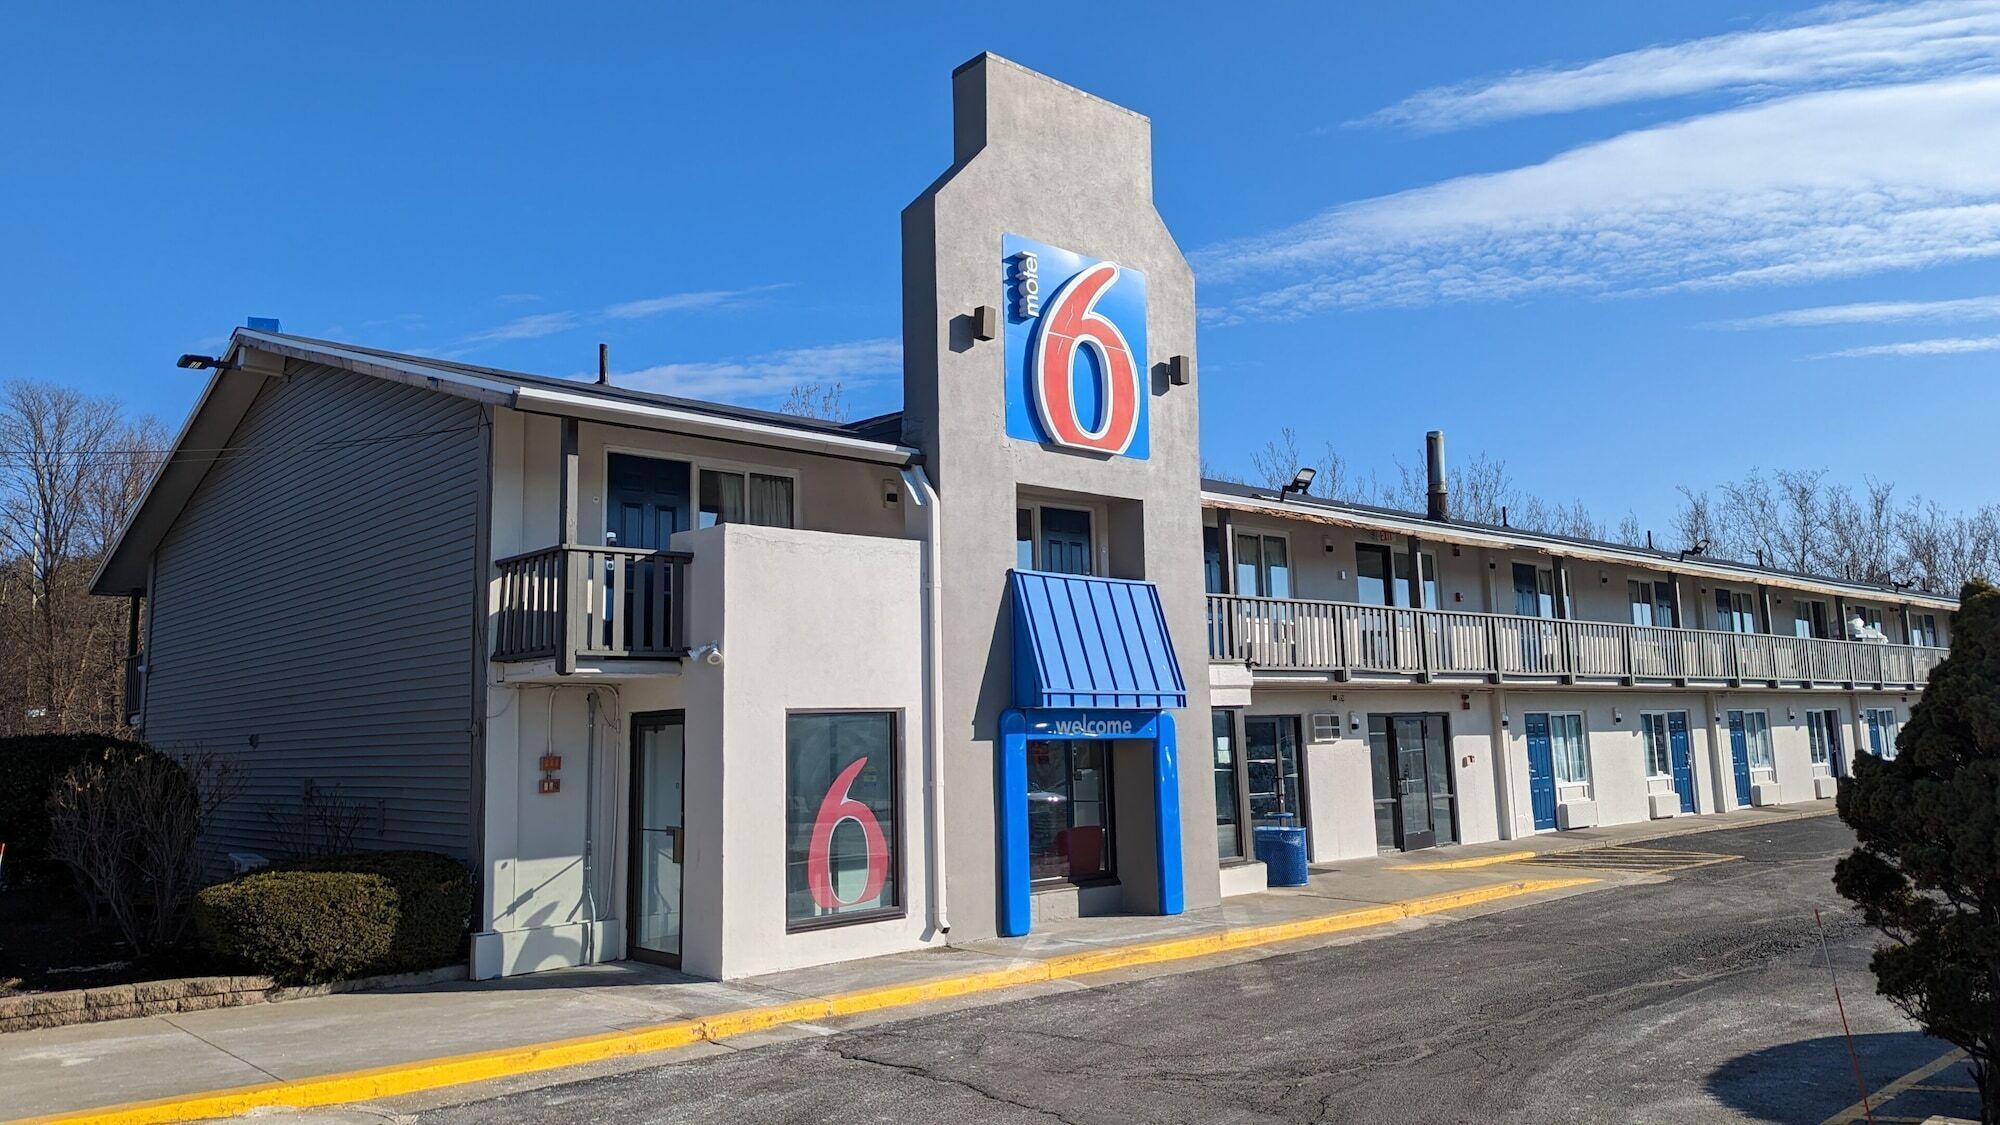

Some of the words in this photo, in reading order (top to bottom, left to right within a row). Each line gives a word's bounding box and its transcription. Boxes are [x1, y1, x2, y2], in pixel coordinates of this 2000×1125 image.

[1023, 251, 1039, 317] motel
[1037, 261, 1140, 454] 6
[1055, 713, 1132, 734] welcome
[808, 757, 889, 908] 6
